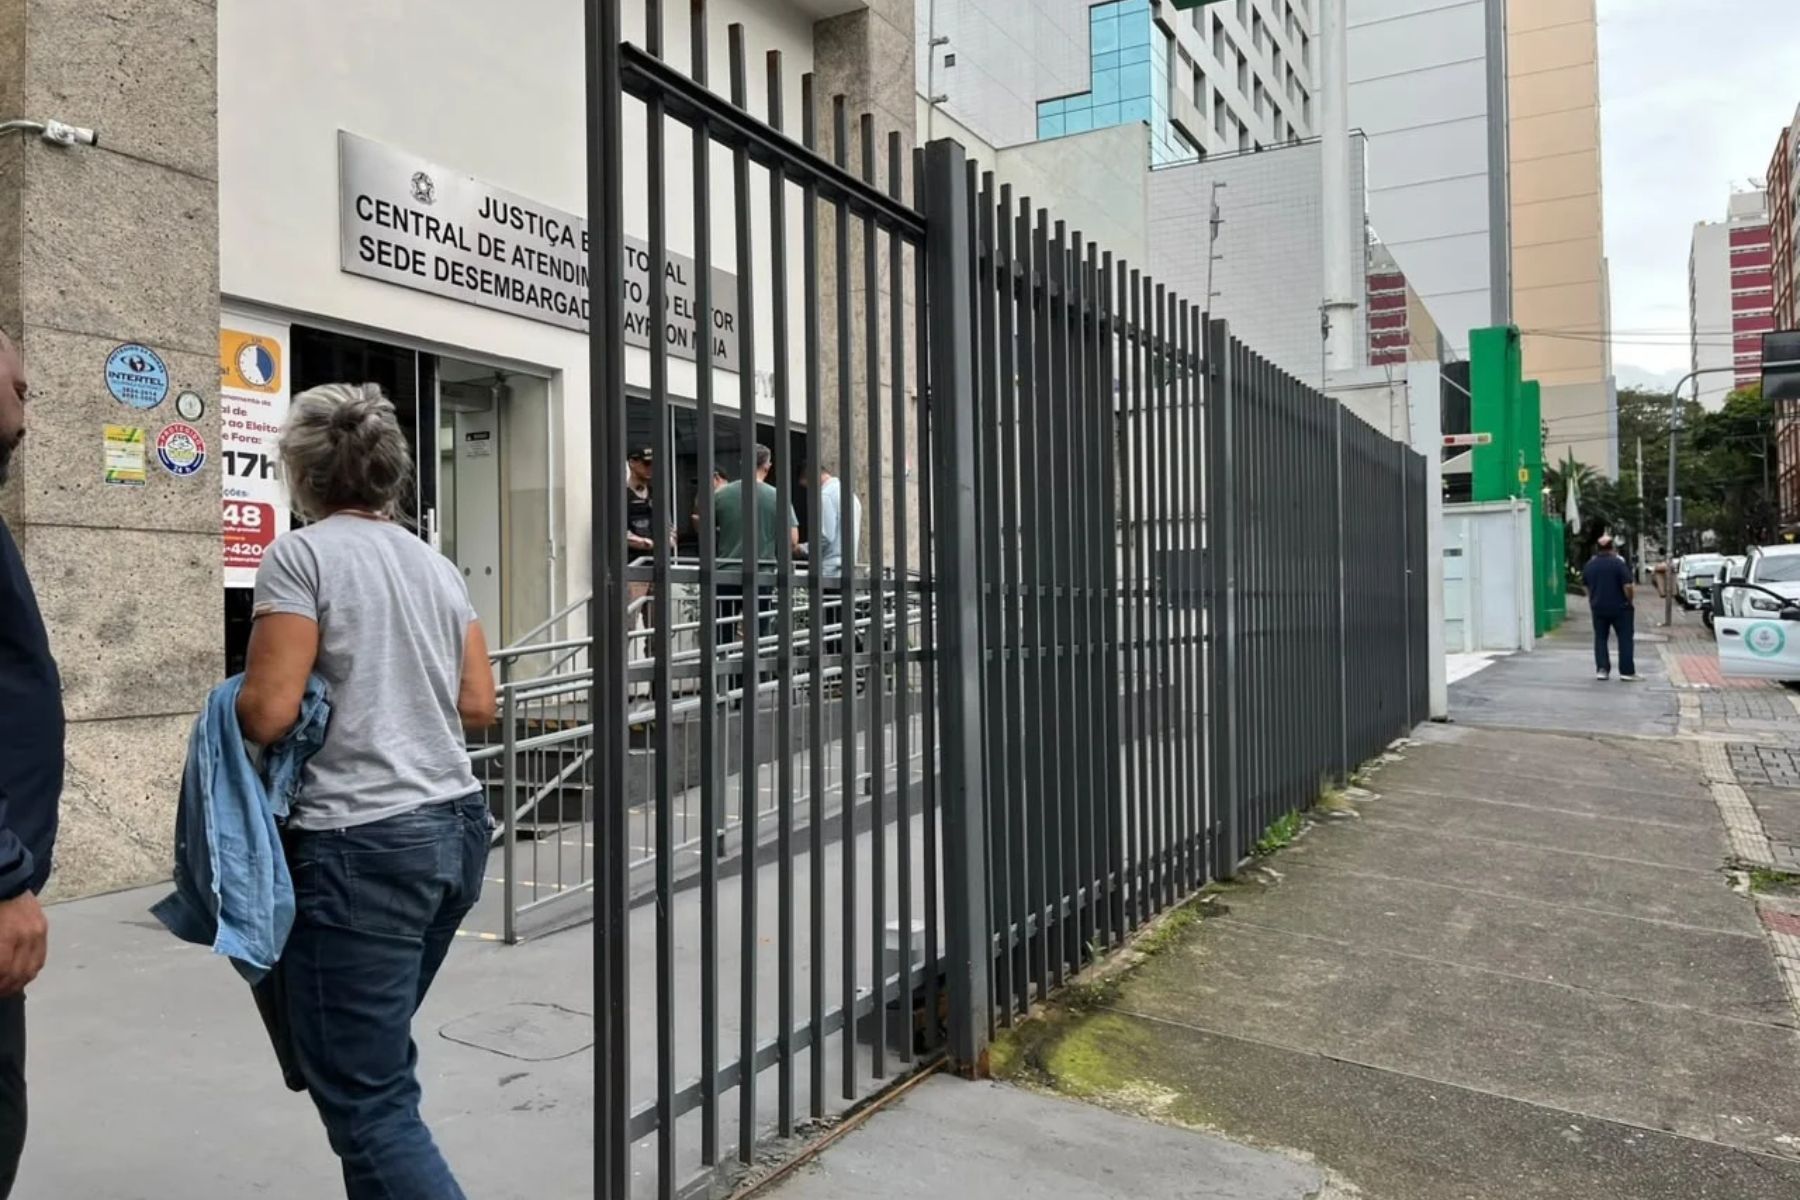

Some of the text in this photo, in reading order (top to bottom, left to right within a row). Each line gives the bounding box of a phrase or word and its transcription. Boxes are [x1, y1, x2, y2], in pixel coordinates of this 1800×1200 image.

[478, 196, 687, 286] JUSTIÇA ETOAL
[356, 194, 472, 252] CENTRAL
[478, 232, 506, 263] DE
[674, 296, 734, 333] ELOR
[359, 235, 426, 277] SEDE
[434, 256, 590, 321] DESEMBARGAD
[108, 371, 164, 387] INTERTEL
[228, 420, 243, 429] ao
[232, 406, 248, 417] de
[222, 450, 280, 480] 17h
